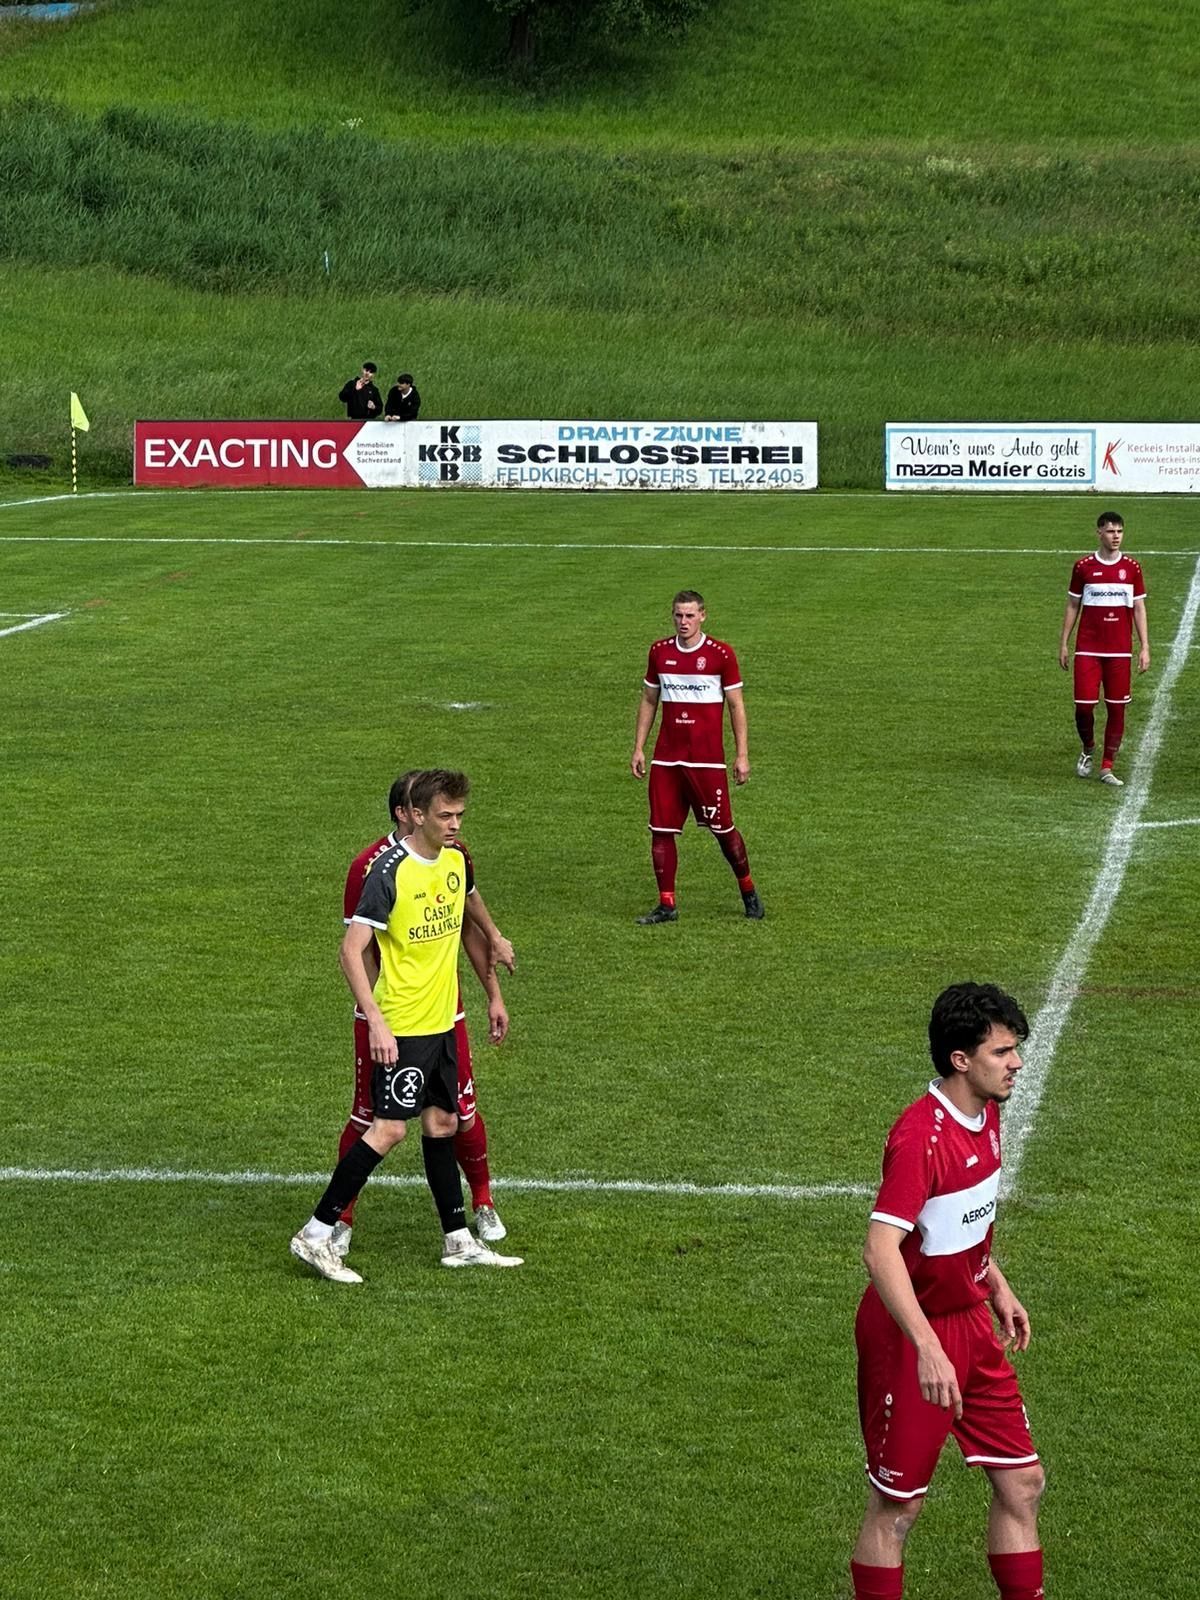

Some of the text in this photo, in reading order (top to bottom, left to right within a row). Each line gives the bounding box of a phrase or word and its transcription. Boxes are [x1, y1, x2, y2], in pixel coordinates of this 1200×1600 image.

[558, 425, 742, 442] DRAHT-ZÄUNE
[144, 438, 338, 468] EXACTING
[496, 445, 804, 465] SCHLOSSEREI
[900, 436, 1081, 461] Wenn's ums Auto geht
[1127, 443, 1164, 453] Keckeis
[896, 460, 1086, 478] mazda Maier Götzis
[1158, 465, 1200, 475] Frastanz
